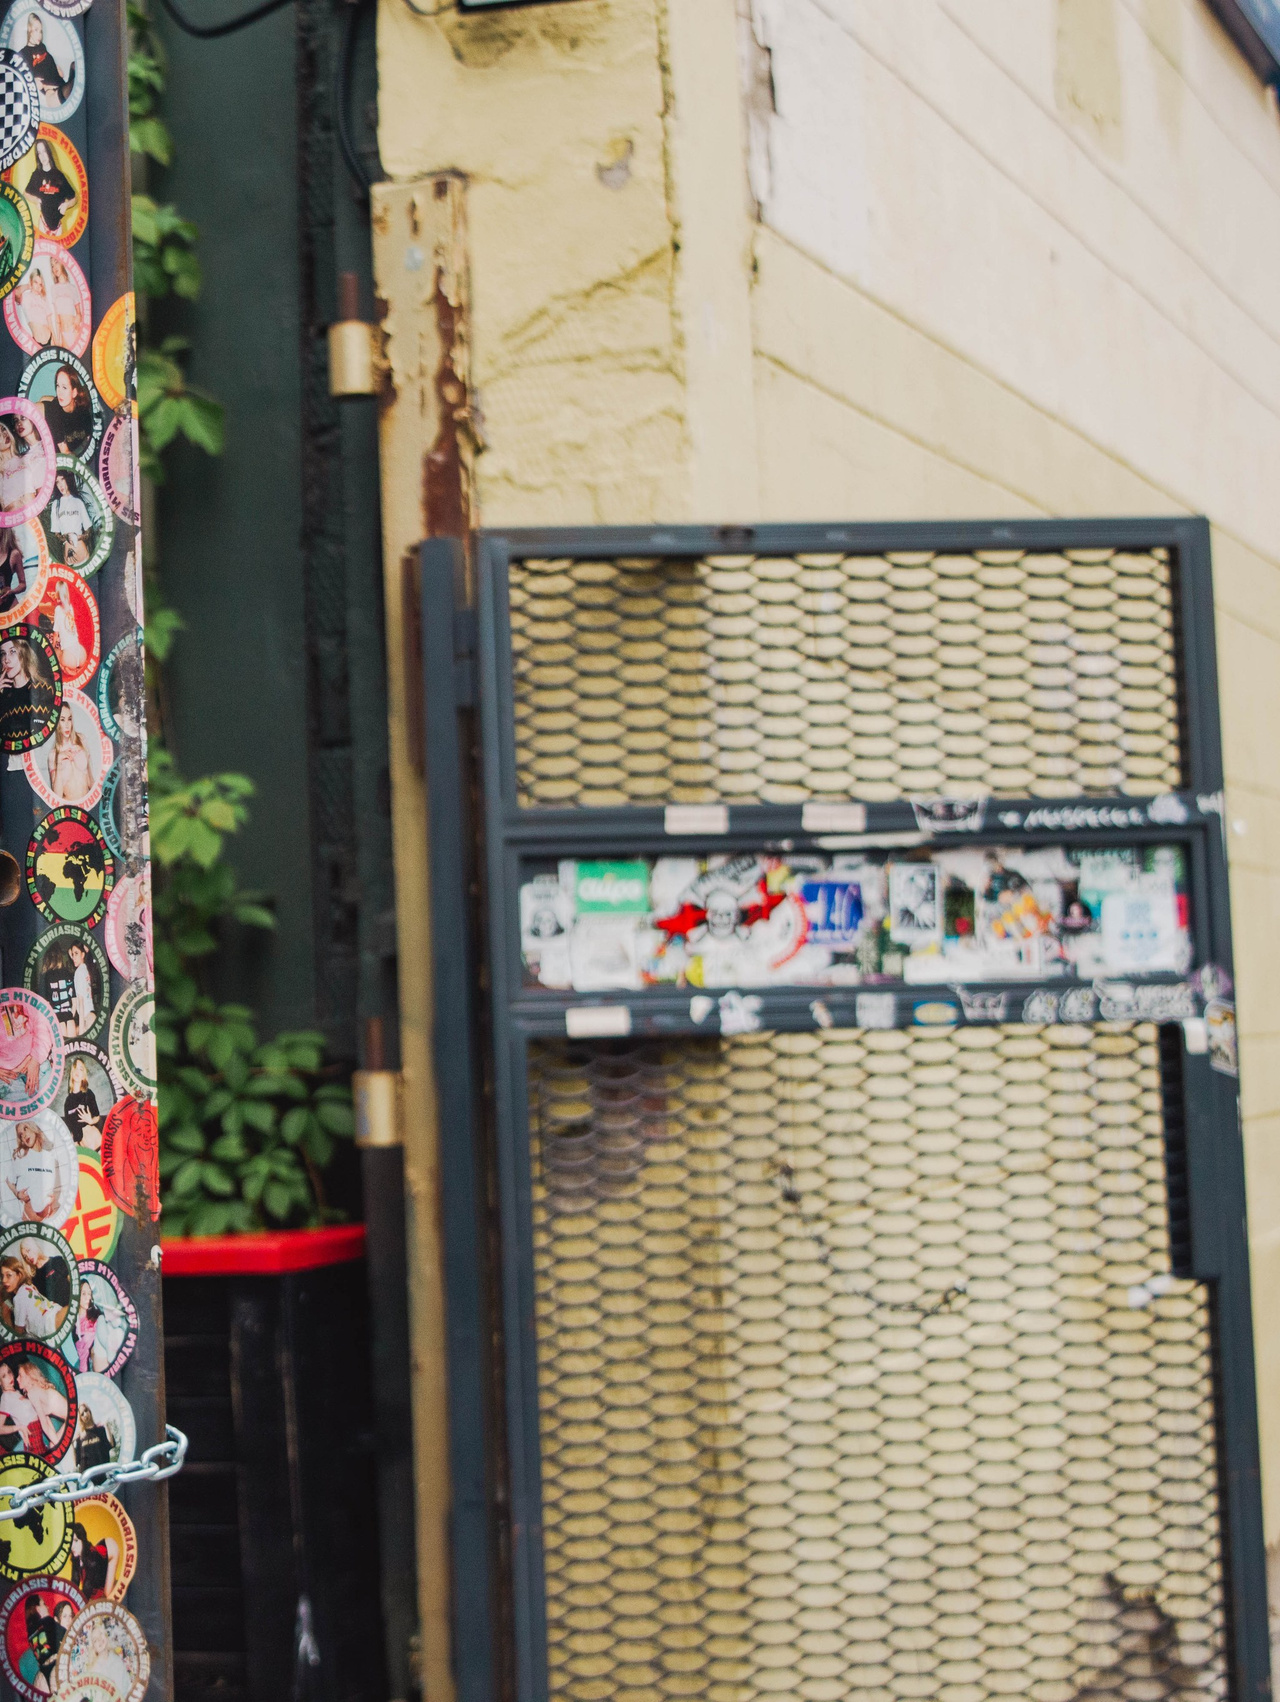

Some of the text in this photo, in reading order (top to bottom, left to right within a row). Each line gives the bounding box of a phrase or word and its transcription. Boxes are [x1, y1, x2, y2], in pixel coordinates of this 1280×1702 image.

[9, 53, 40, 130] MYDRIASIS
[4, 187, 33, 262] MYDRIASIS
[59, 350, 102, 414] MYDRIASIS
[75, 461, 114, 532] MYDRIASIS
[101, 432, 121, 510] MYDRIASIS
[75, 578, 100, 658] MYDRIASIS
[30, 629, 61, 707] MYDRIASIS
[4, 708, 59, 751] MYDRIASIS
[33, 807, 89, 841] MYDRIASIS
[89, 820, 114, 900] MYDRIASIS
[26, 840, 54, 922] MYDRIASIS
[29, 924, 110, 1010] MYDRIASIS MYDRIASIS
[13, 990, 63, 1116] MYDRIASIS MYDRIASIS
[104, 1113, 124, 1179] MYDRIASIS
[41, 1225, 79, 1296] MYDRIASIS
[97, 1263, 138, 1329] MYDRIASIS
[26, 1341, 77, 1400] MYDRIASIS
[110, 1499, 134, 1579] MYDRIASIS
[65, 1601, 113, 1651] MYDRIASIS
